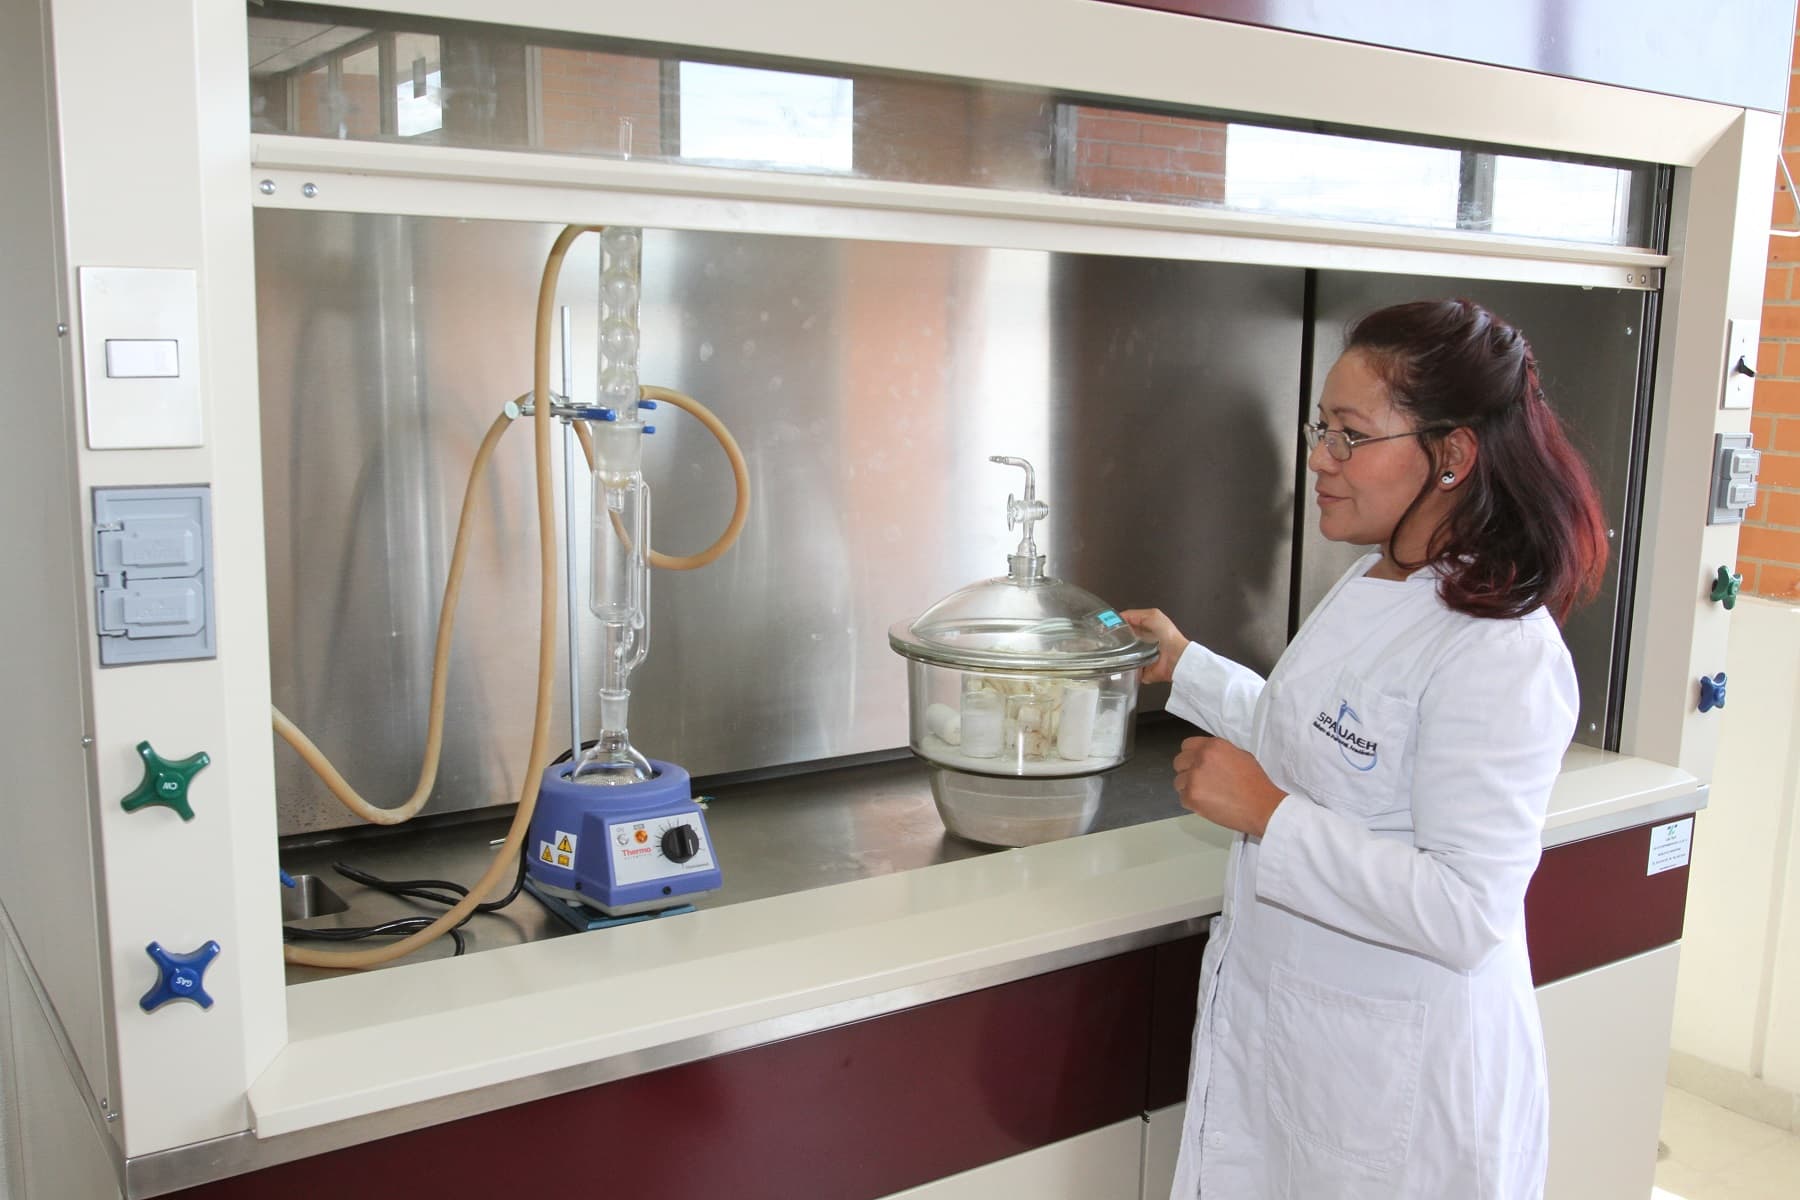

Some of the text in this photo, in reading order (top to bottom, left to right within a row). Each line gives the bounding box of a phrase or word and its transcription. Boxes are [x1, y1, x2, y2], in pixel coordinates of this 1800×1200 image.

[1317, 711, 1377, 752] SPAUAEH
[163, 782, 178, 790] CW
[623, 847, 652, 857] Thermo
[176, 976, 193, 987] GAS
